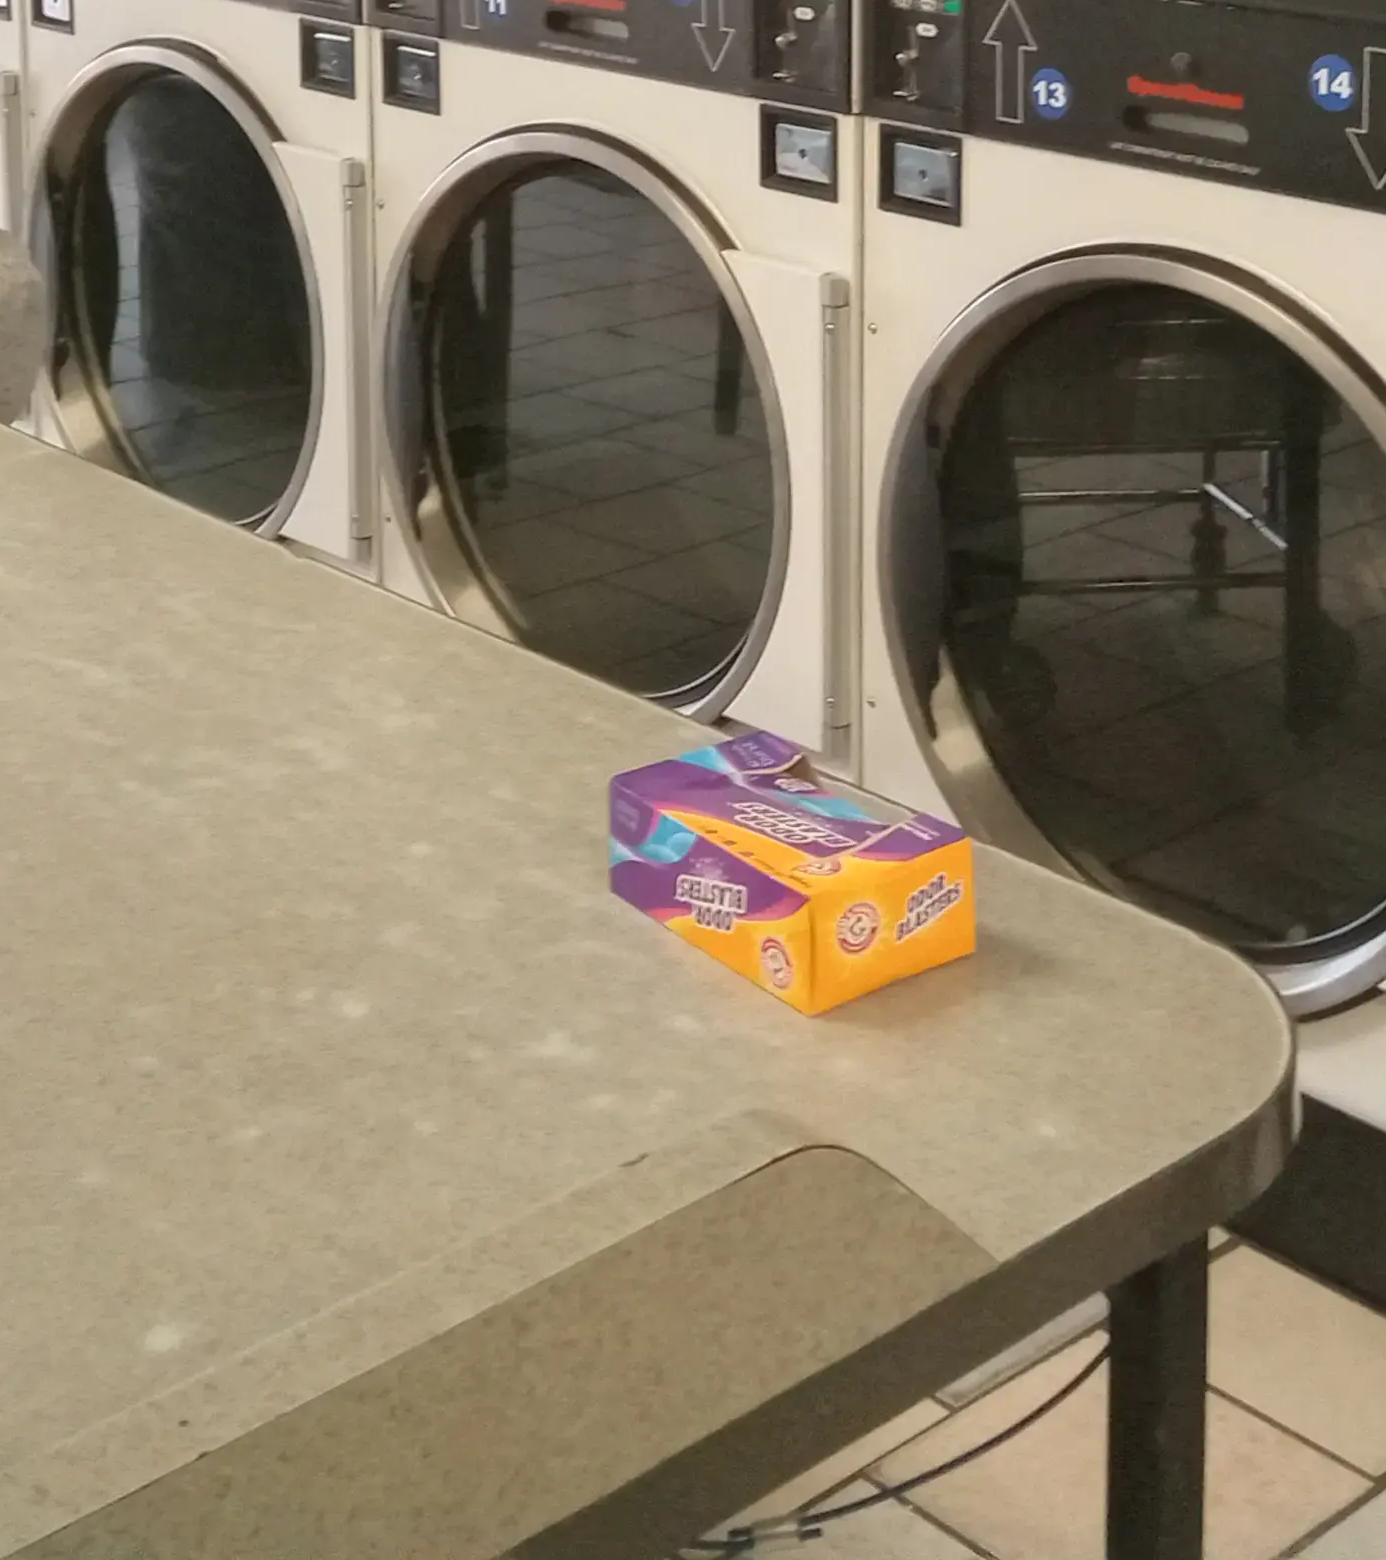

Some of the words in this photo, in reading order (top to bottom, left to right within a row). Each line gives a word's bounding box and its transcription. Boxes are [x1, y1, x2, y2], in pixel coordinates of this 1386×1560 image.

[1033, 80, 1068, 109] 13
[1312, 67, 1353, 100] 14
[735, 815, 811, 842] ODOR
[907, 872, 946, 914] ODOR
[694, 905, 733, 931] ODOR
